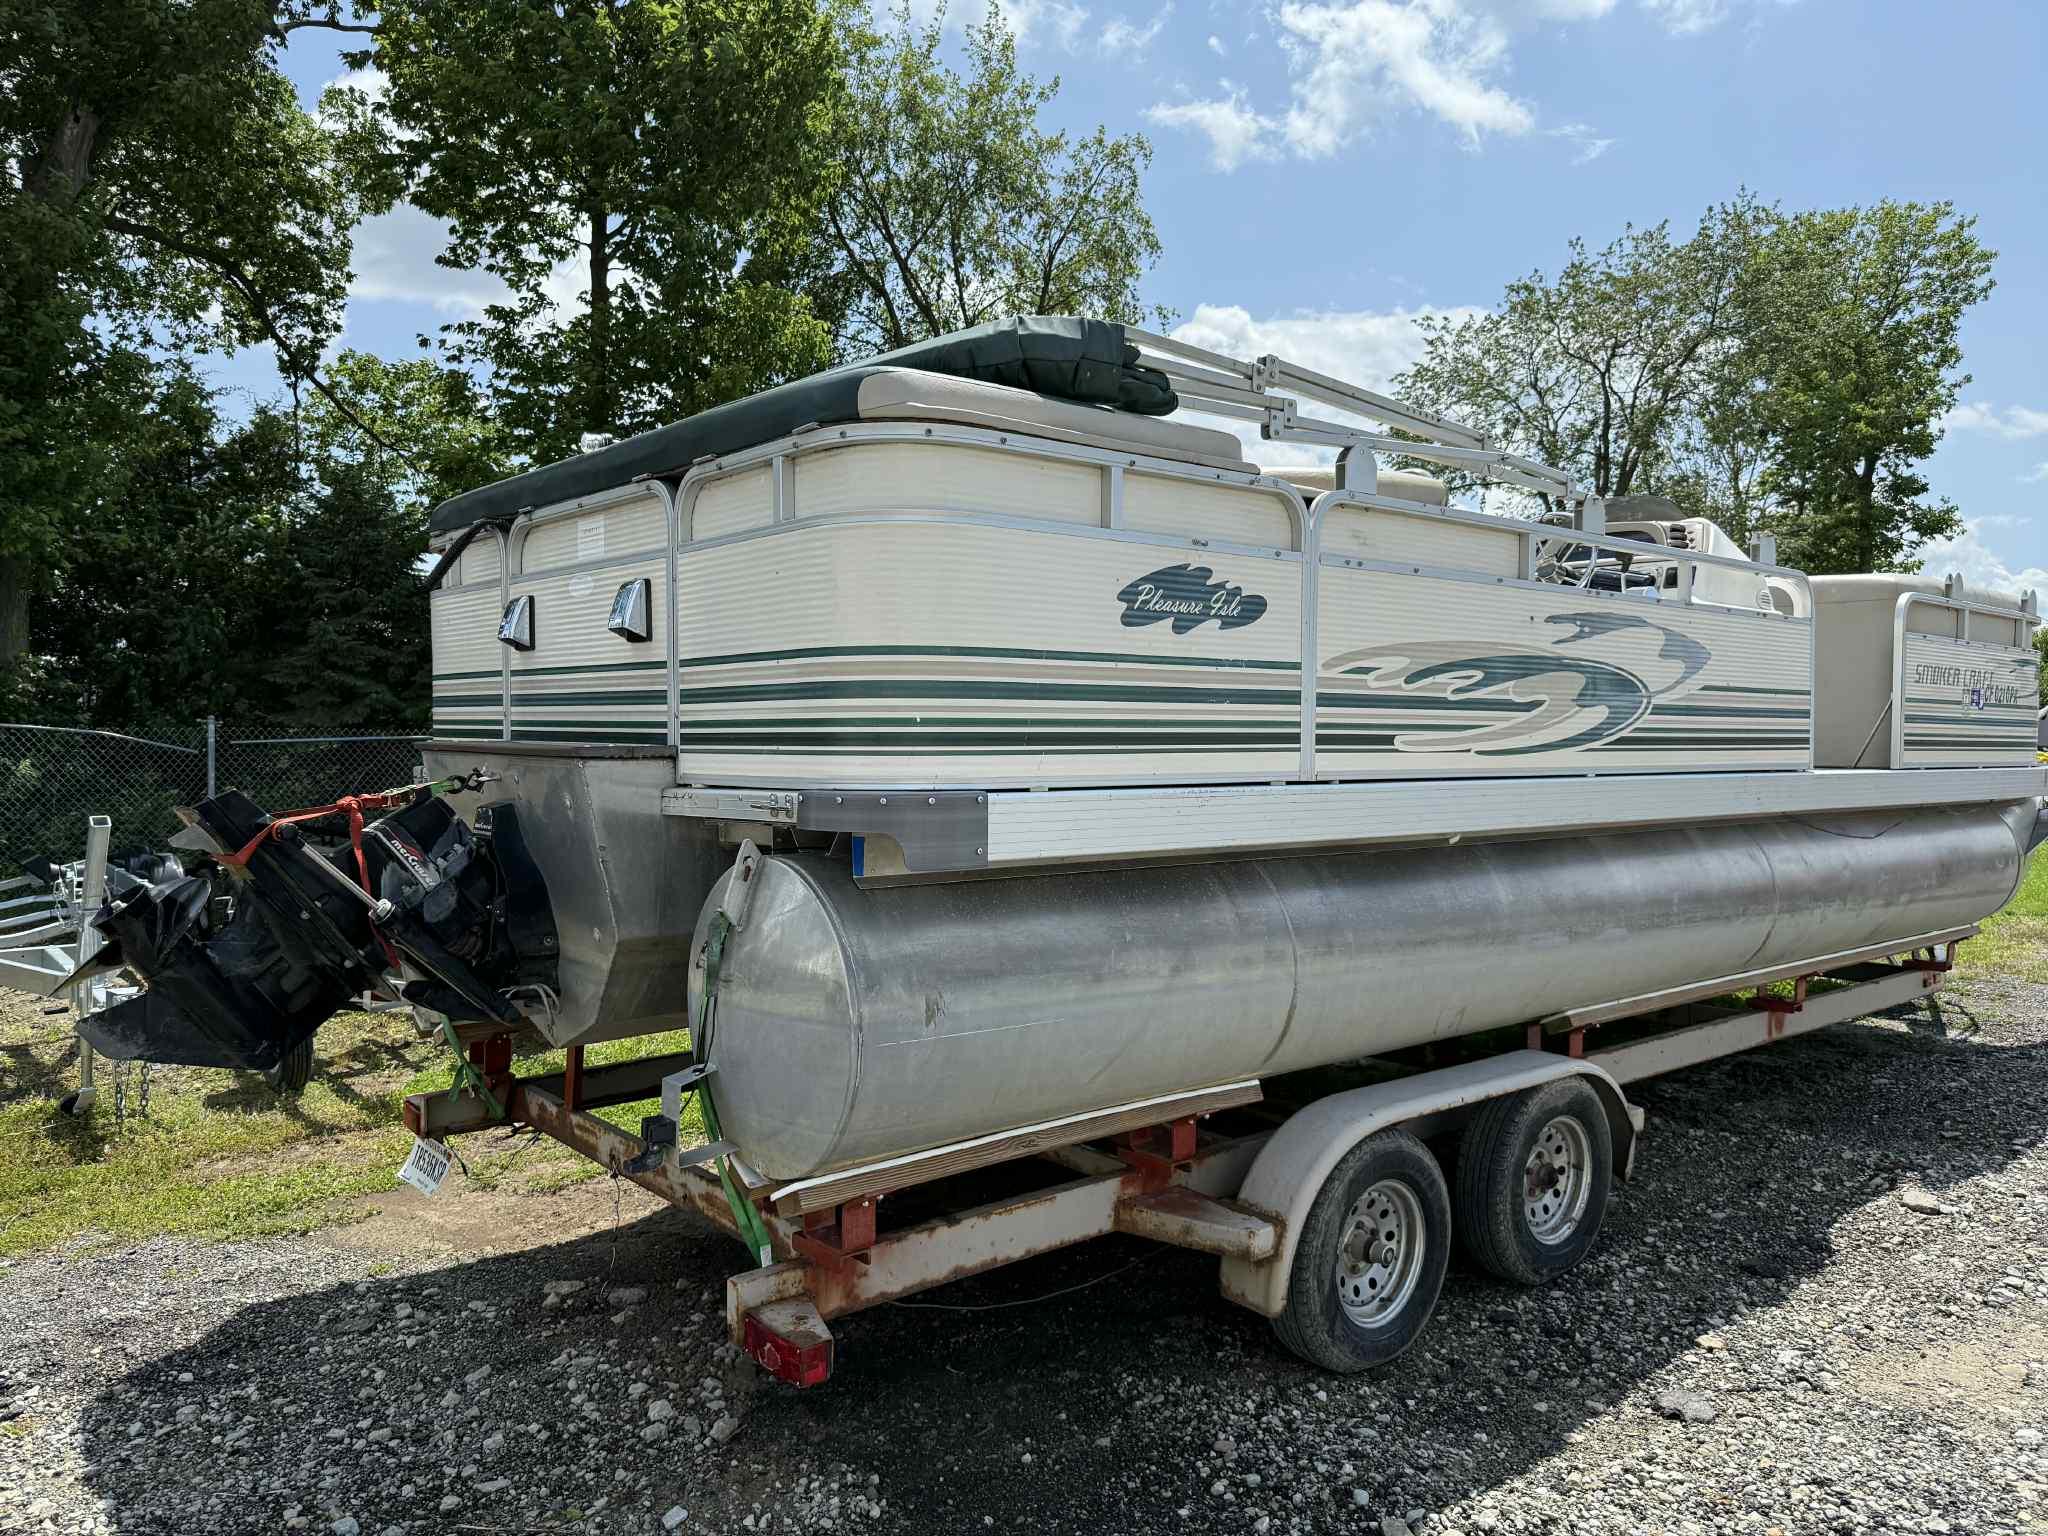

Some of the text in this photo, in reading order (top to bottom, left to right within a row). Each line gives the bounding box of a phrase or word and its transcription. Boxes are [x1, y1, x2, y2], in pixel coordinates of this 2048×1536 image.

[1134, 584, 1242, 617] Pleasure Isle
[1914, 664, 1961, 687] SMOKER
